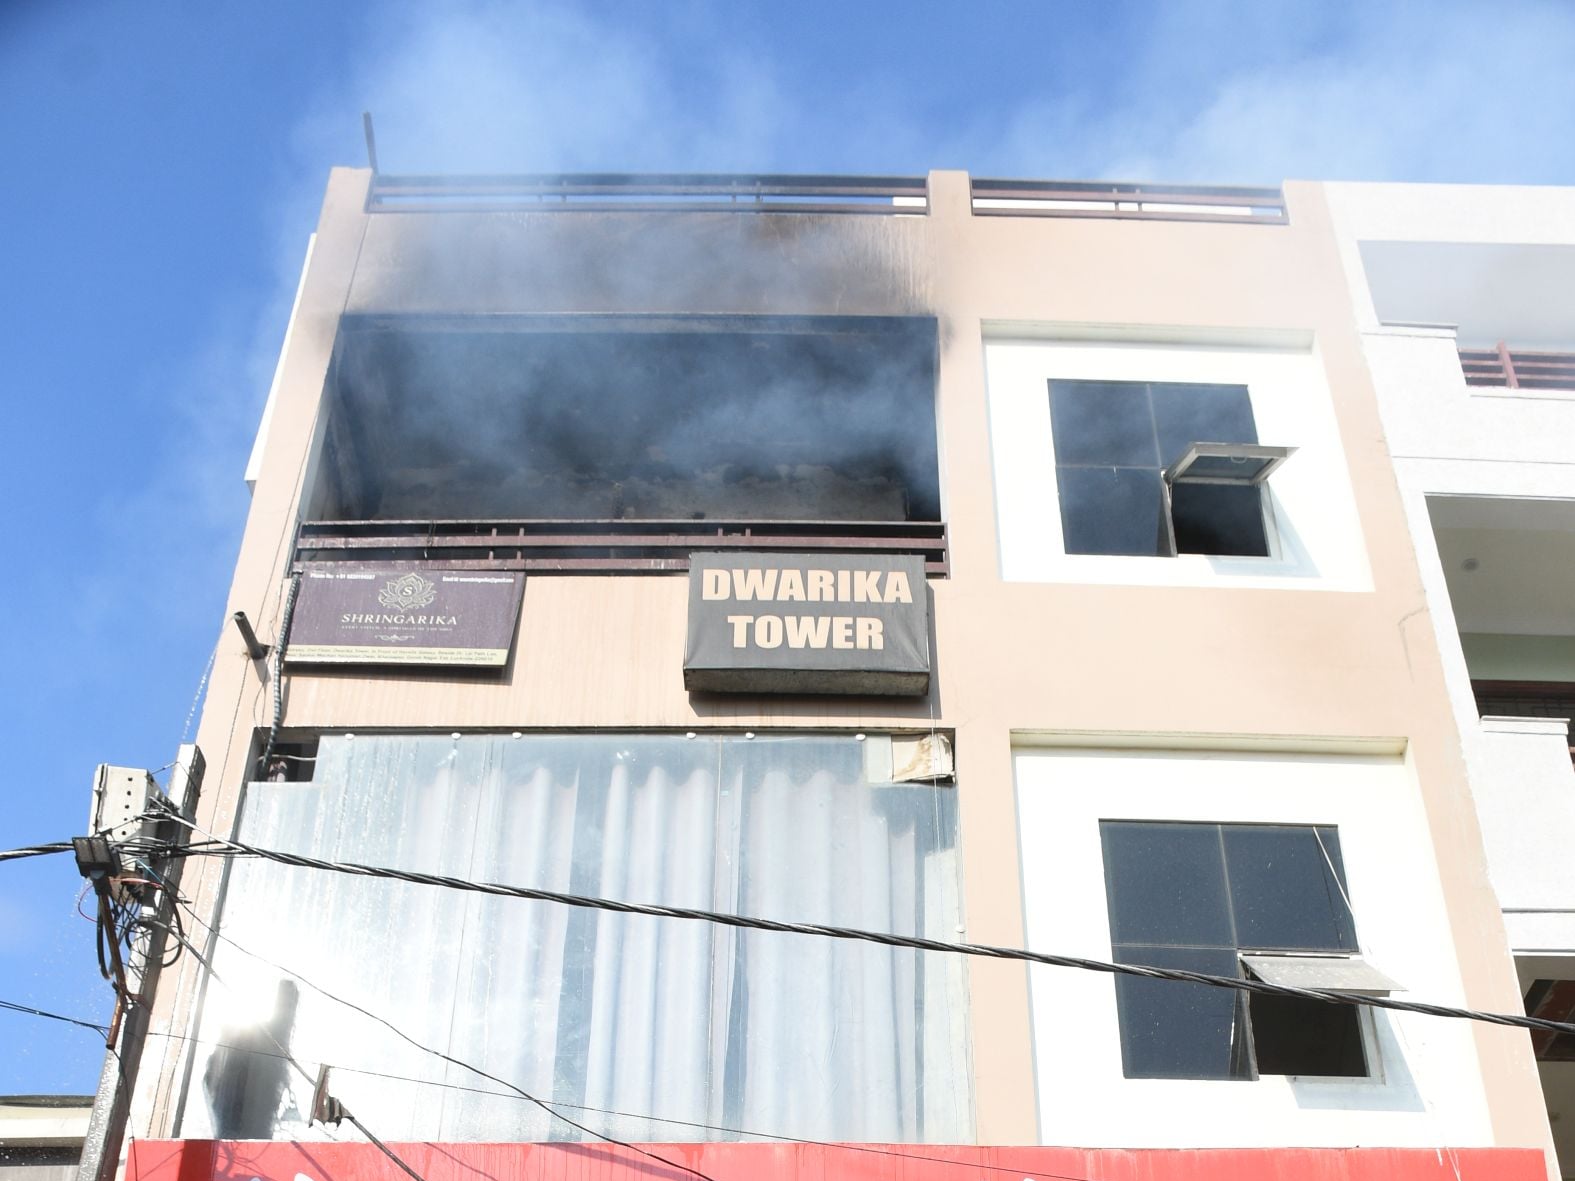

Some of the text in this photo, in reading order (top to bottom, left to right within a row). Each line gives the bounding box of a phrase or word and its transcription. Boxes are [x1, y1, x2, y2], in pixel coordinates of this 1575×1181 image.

[402, 586, 413, 596] S
[702, 568, 913, 604] DWARIKA
[341, 613, 457, 625] SHRINGARIKA
[727, 615, 884, 650] TOWER
